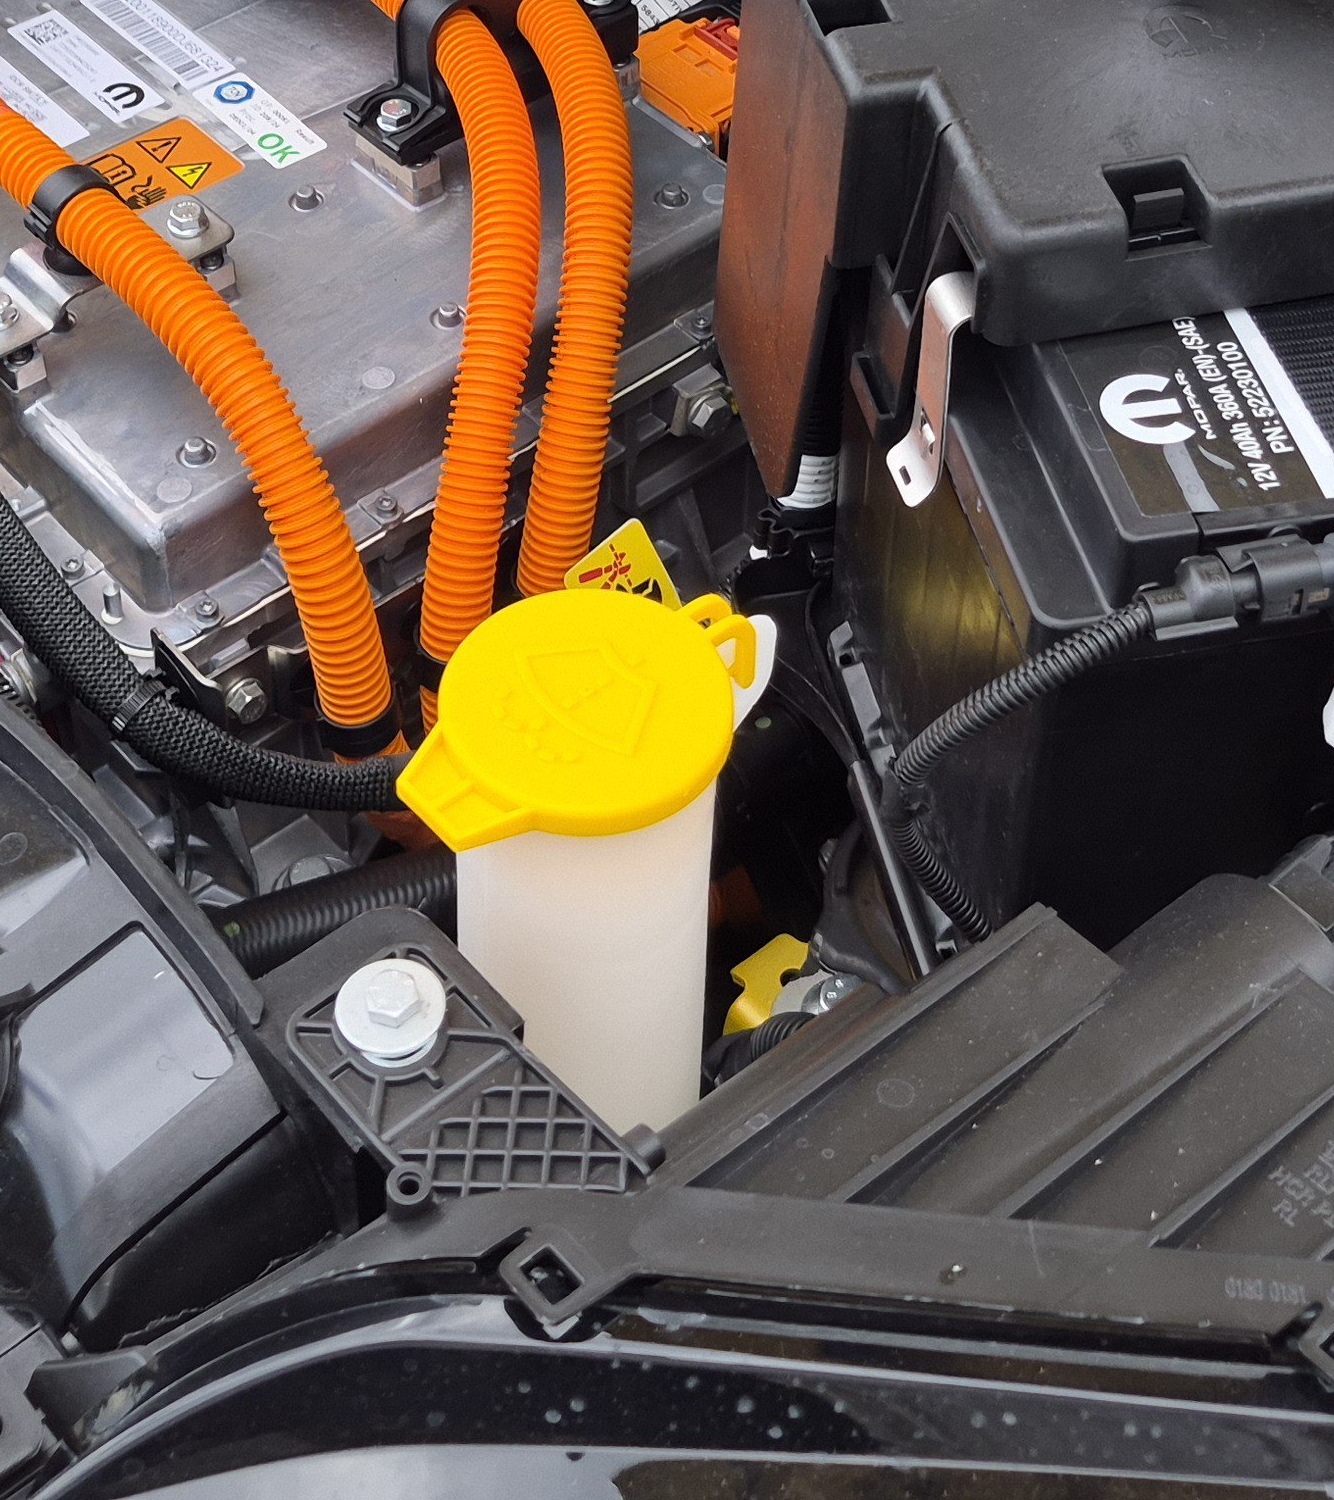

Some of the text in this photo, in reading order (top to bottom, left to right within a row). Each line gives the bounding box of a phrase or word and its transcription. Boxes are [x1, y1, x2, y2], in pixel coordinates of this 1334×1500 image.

[257, 133, 300, 164] OK
[1172, 316, 1281, 491] 12V 40Ah 360A (EN)-(SAE)
[1217, 341, 1294, 454] PN: 52230100
